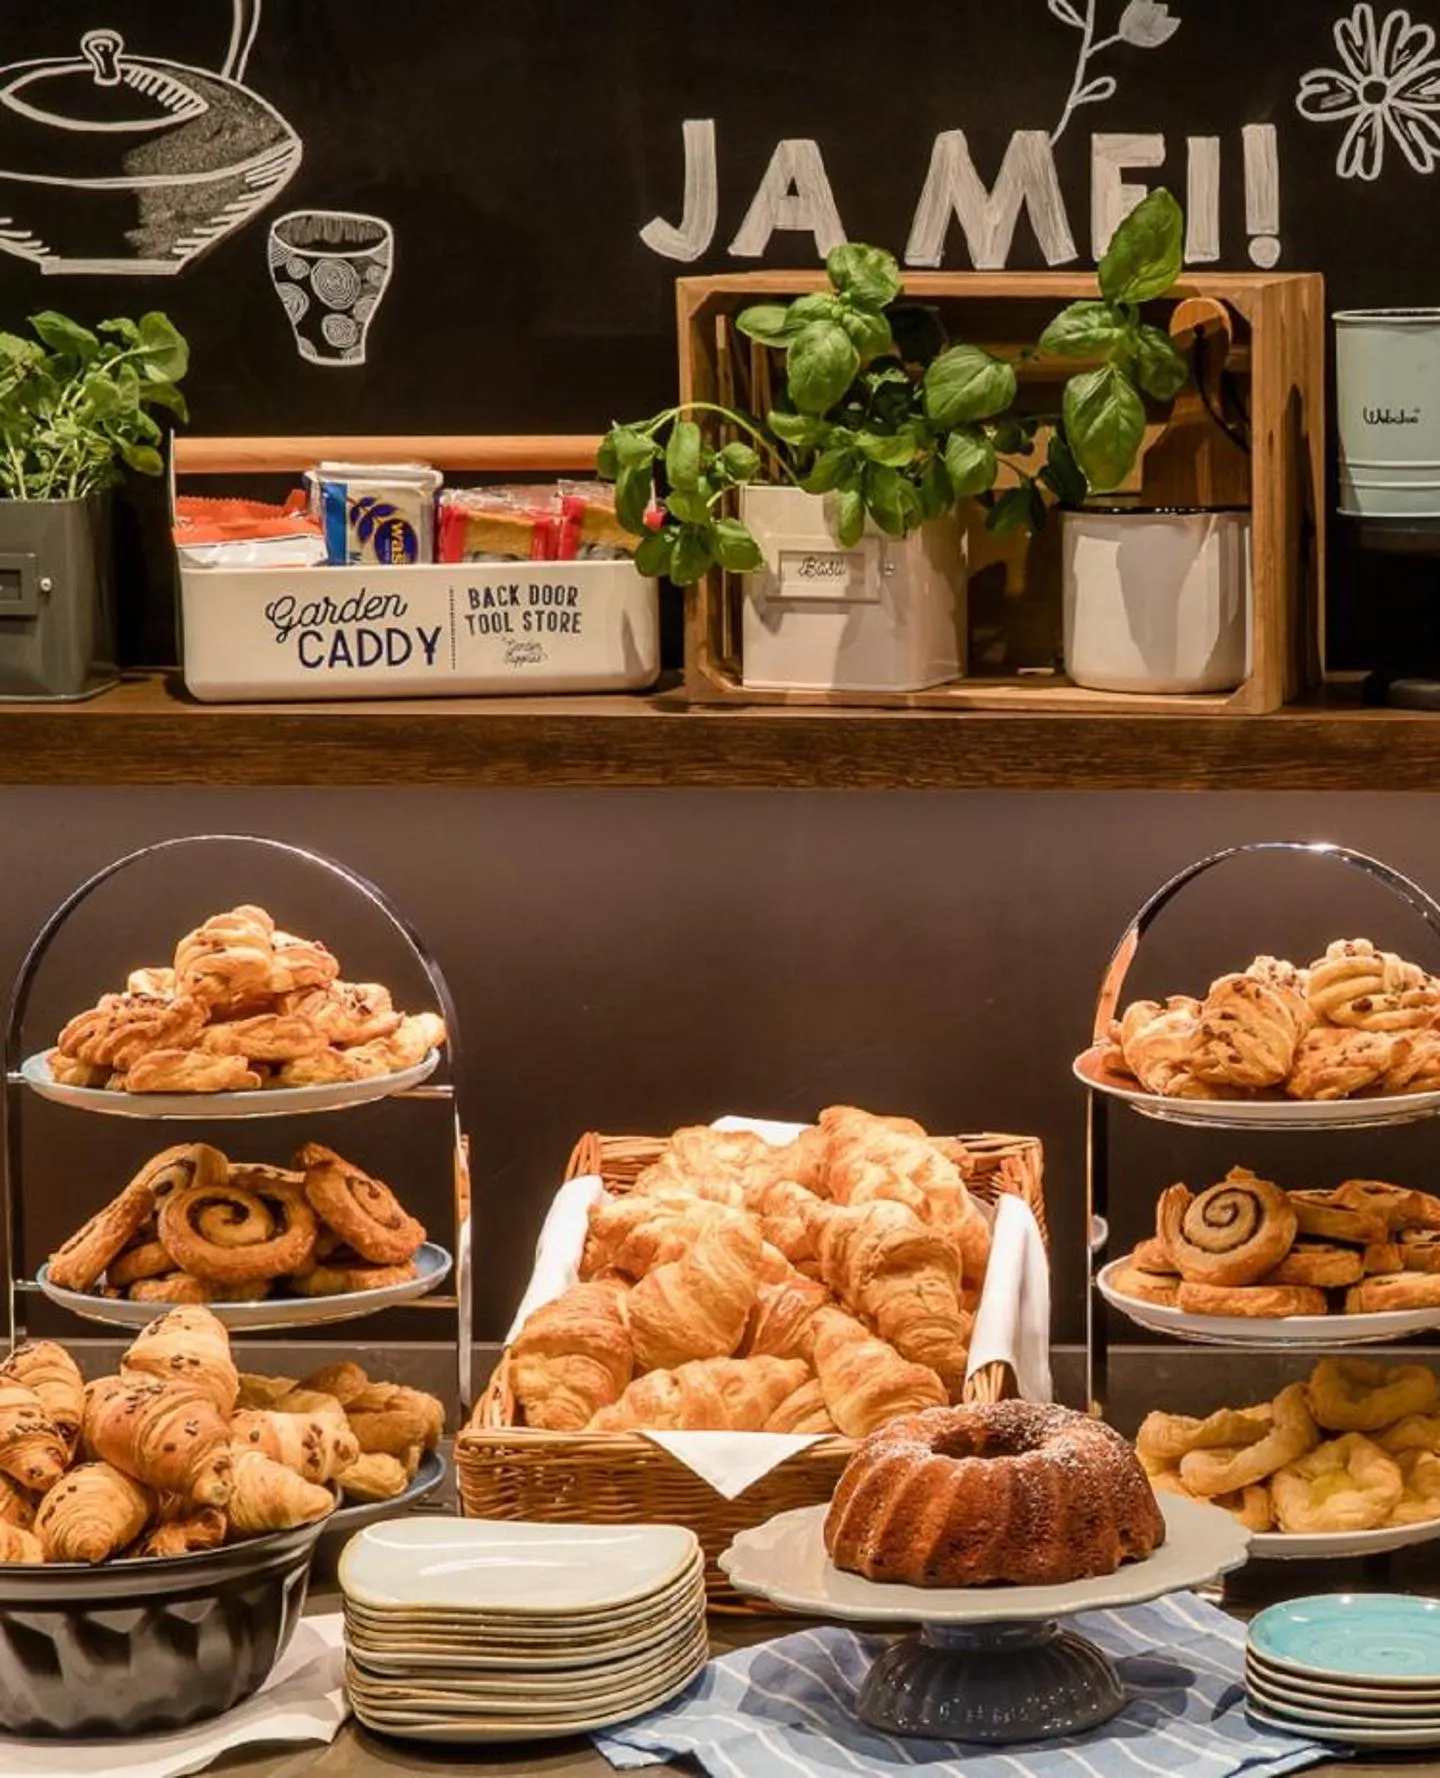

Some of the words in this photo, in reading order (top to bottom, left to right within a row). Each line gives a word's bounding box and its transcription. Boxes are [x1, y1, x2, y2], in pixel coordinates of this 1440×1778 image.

[638, 118, 849, 263] JA
[265, 587, 408, 644] Garden
[468, 584, 521, 611] BACK
[529, 584, 579, 607] DOOR
[464, 611, 514, 636] TOOL
[522, 610, 582, 633] STORE
[297, 625, 442, 669] CADDY
